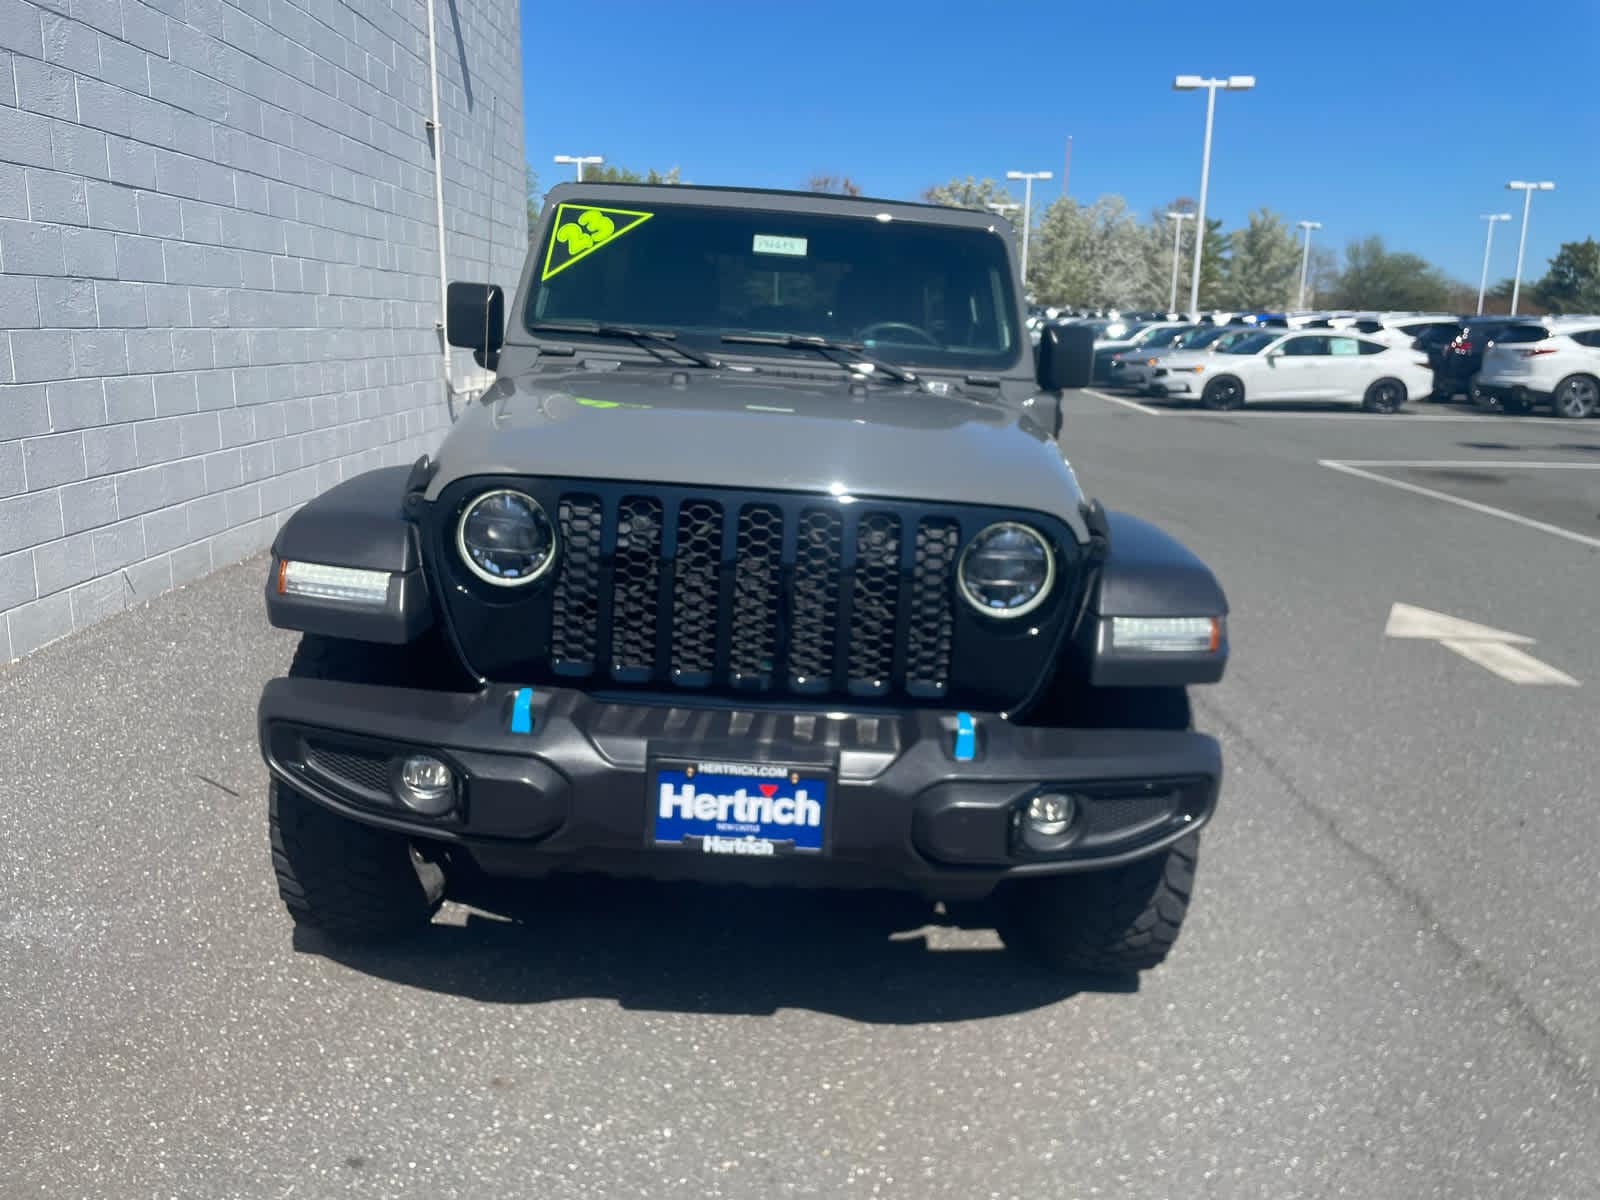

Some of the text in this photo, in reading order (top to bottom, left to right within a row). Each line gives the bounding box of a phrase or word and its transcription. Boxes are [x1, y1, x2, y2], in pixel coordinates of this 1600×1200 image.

[557, 210, 615, 255] 23
[697, 762, 789, 778] HERTRICH.COM
[659, 783, 821, 827] Hertrich
[702, 836, 774, 856] Hertrich
